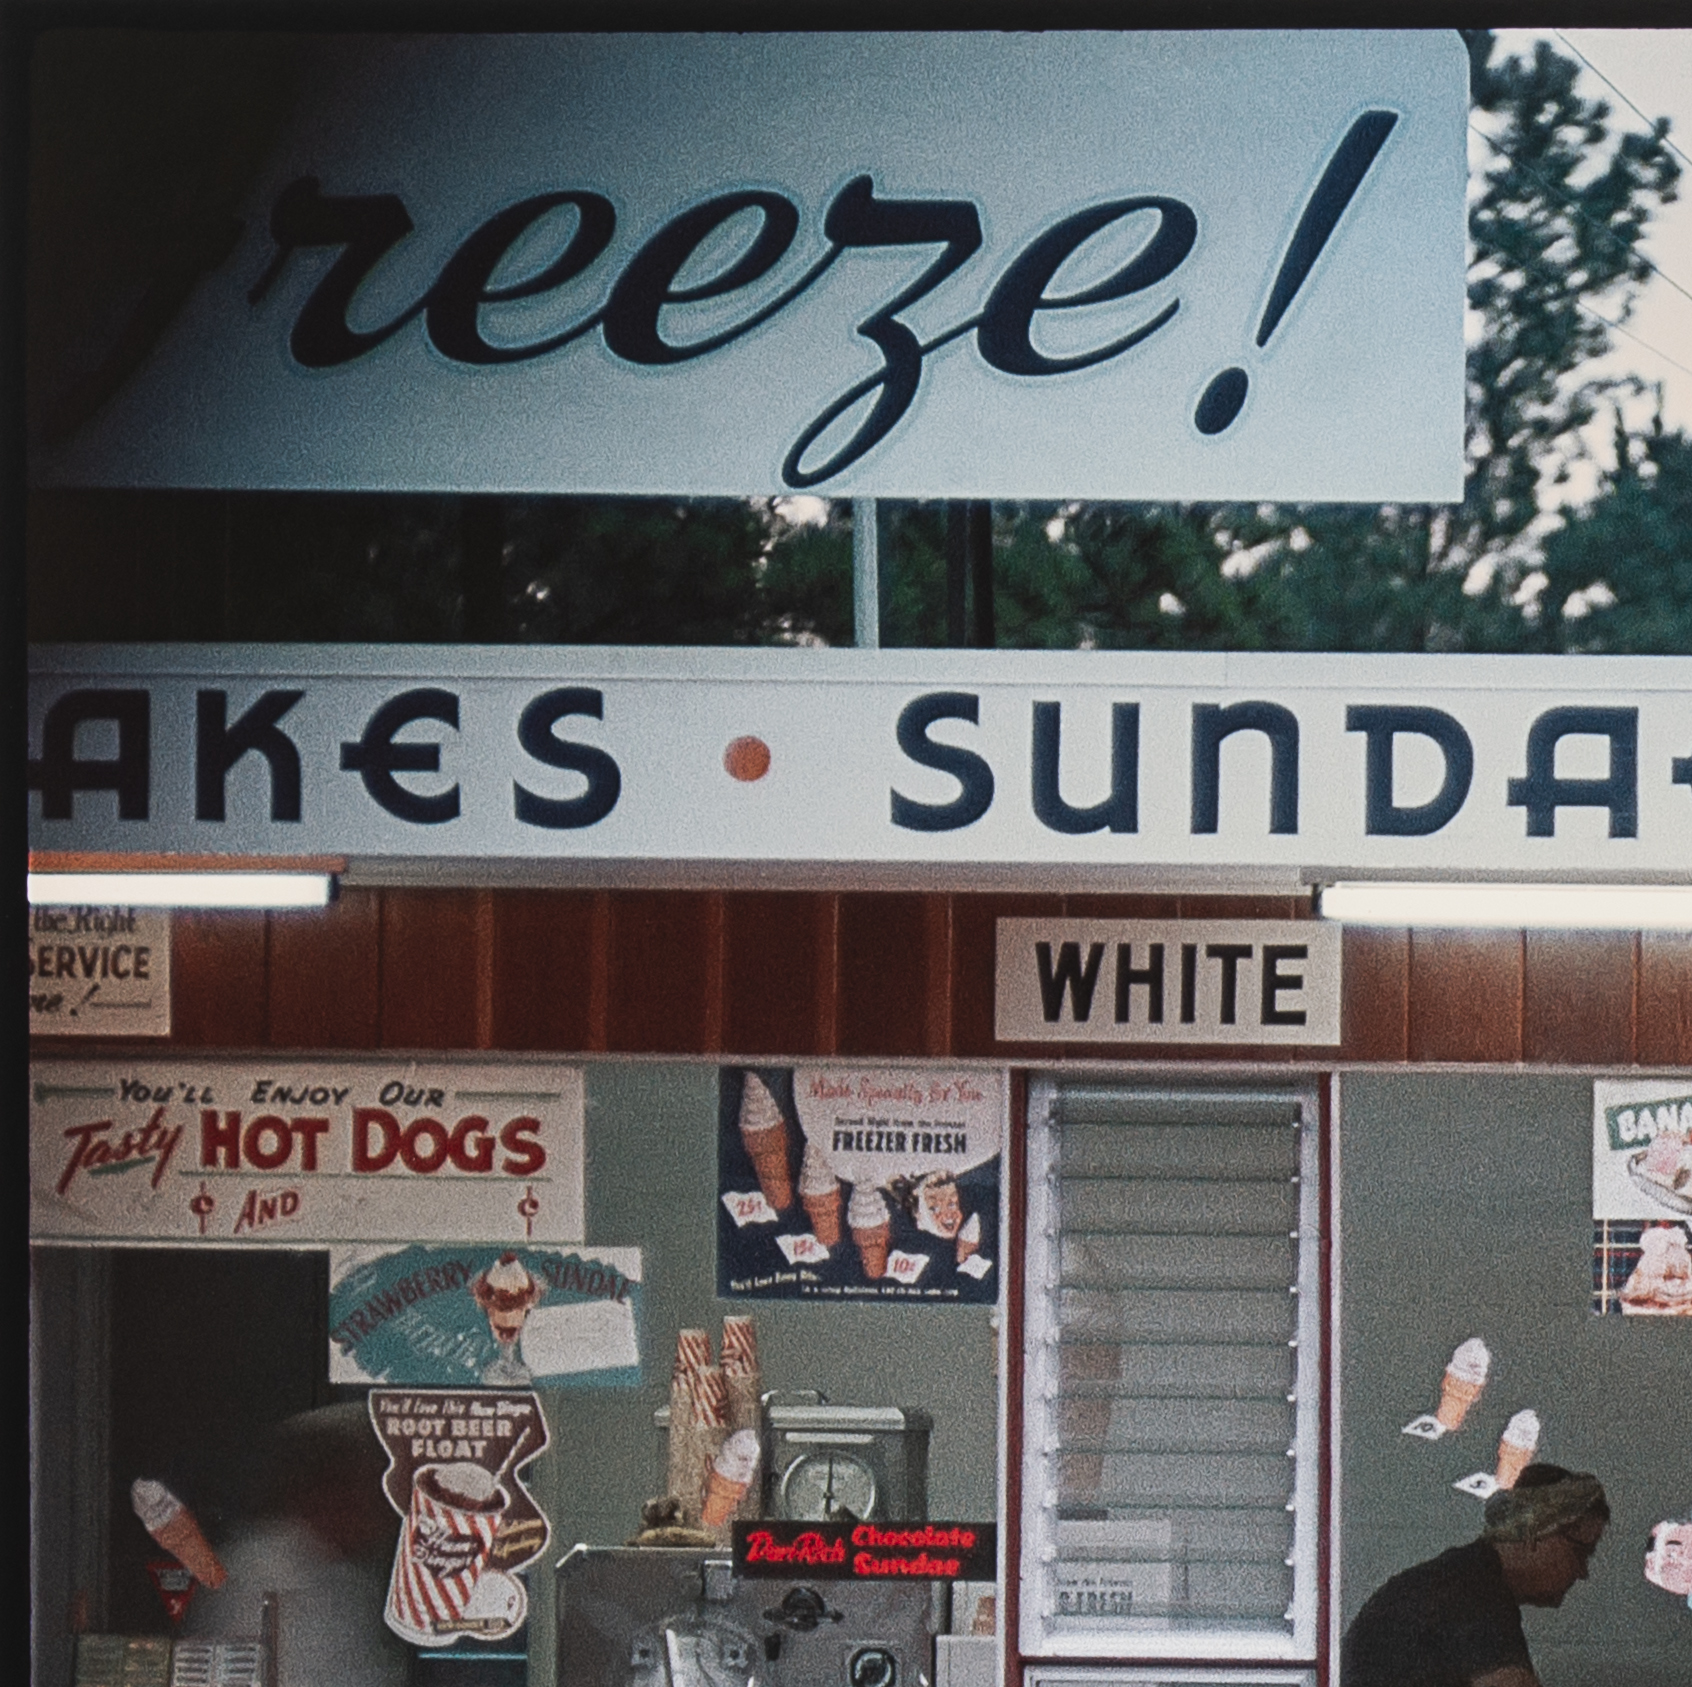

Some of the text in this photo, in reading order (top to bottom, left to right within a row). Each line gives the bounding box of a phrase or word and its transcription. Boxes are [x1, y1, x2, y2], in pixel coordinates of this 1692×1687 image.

[1036, 942, 1308, 1025] WHITE
[251, 1079, 350, 1107] ENJOY
[378, 1081, 446, 1108] OUR
[55, 1106, 548, 1195] Tasty HOT DOGS
[832, 1130, 967, 1154] FREEZER FRESH
[234, 1190, 301, 1235] AND
[330, 1260, 474, 1346] STRAWBERRY
[386, 1418, 512, 1437] ROOT BEER
[411, 1439, 487, 1458] FLOAT
[852, 1525, 976, 1548] Chocolate
[853, 1552, 960, 1576] Sundae
